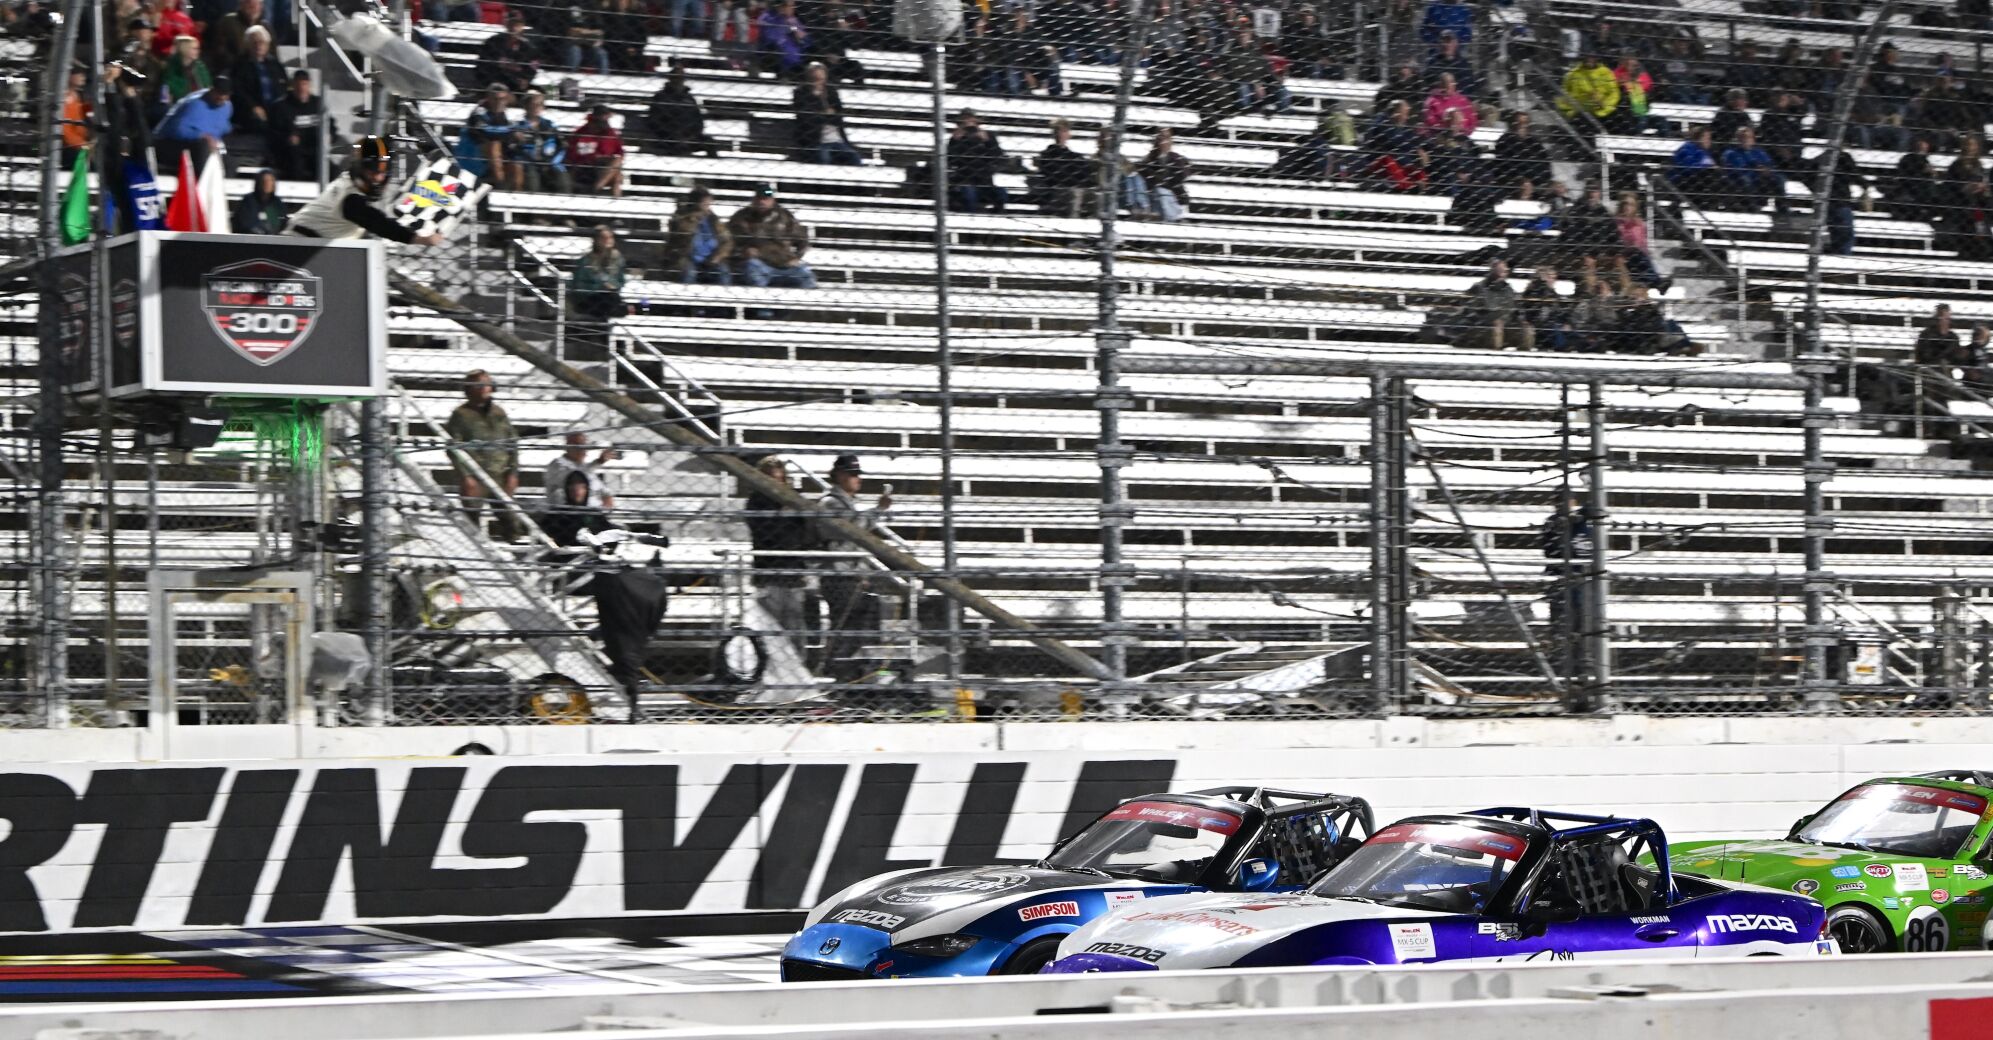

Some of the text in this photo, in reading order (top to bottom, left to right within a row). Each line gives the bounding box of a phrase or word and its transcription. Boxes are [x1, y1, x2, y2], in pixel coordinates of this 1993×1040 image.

[229, 312, 298, 334] 300
[1021, 902, 1077, 920] SIMPSON
[1630, 915, 1671, 925] WORKMAN
[1908, 917, 1945, 952] 86
